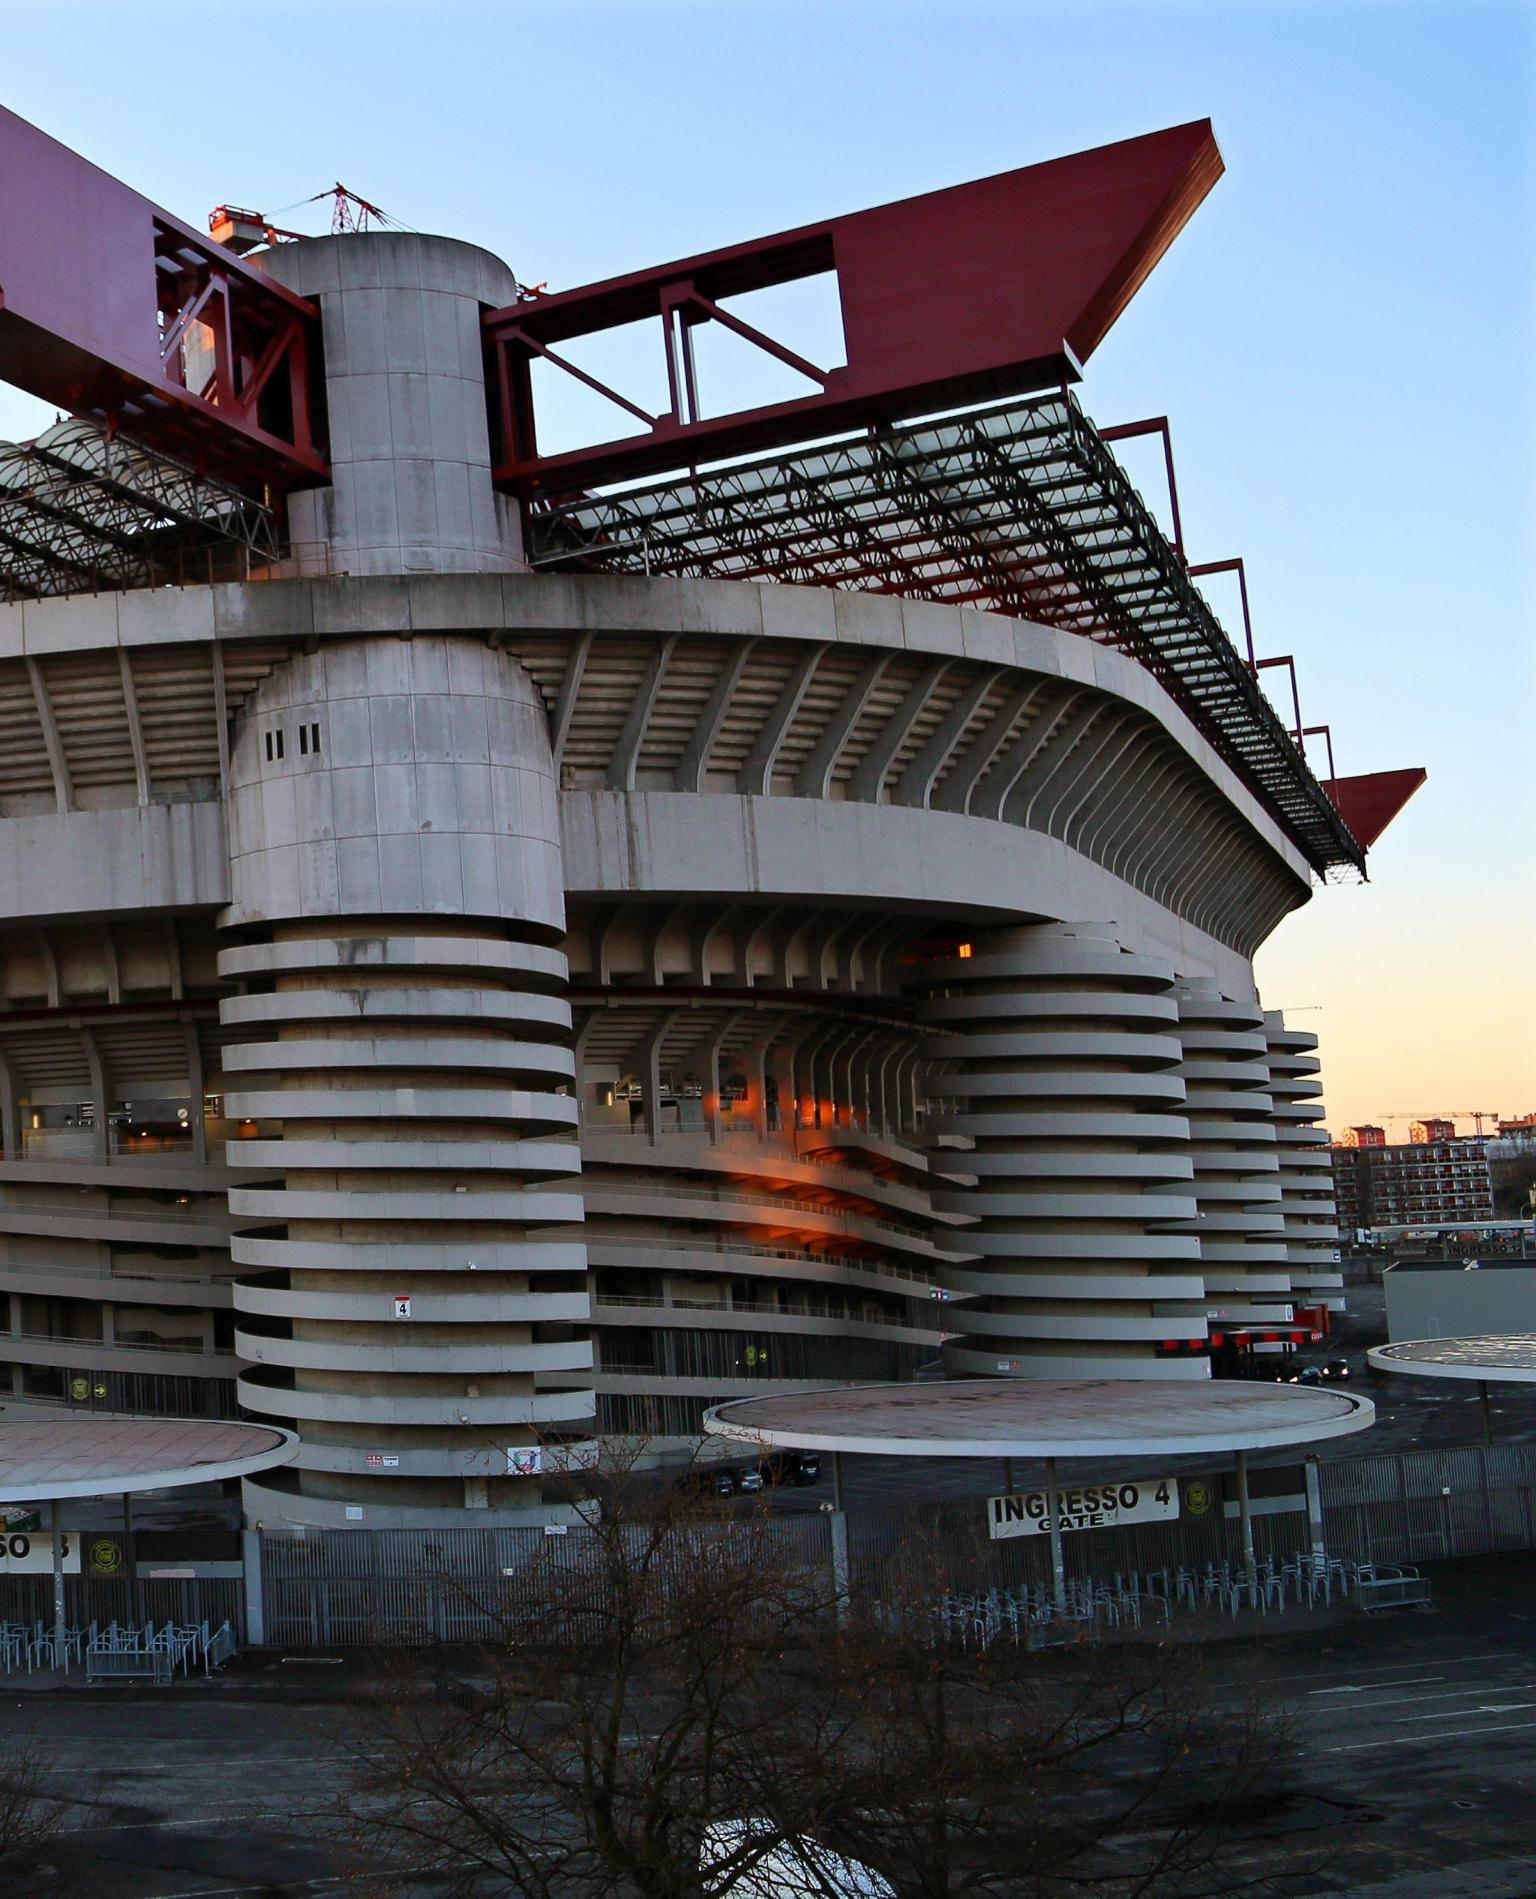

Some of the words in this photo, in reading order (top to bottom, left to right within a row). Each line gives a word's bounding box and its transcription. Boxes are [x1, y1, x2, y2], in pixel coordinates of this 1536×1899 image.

[399, 1303, 407, 1314] 4
[994, 1485, 1139, 1523] INGRESSO
[1154, 1482, 1170, 1506] 4
[1038, 1513, 1104, 1531] GATE
